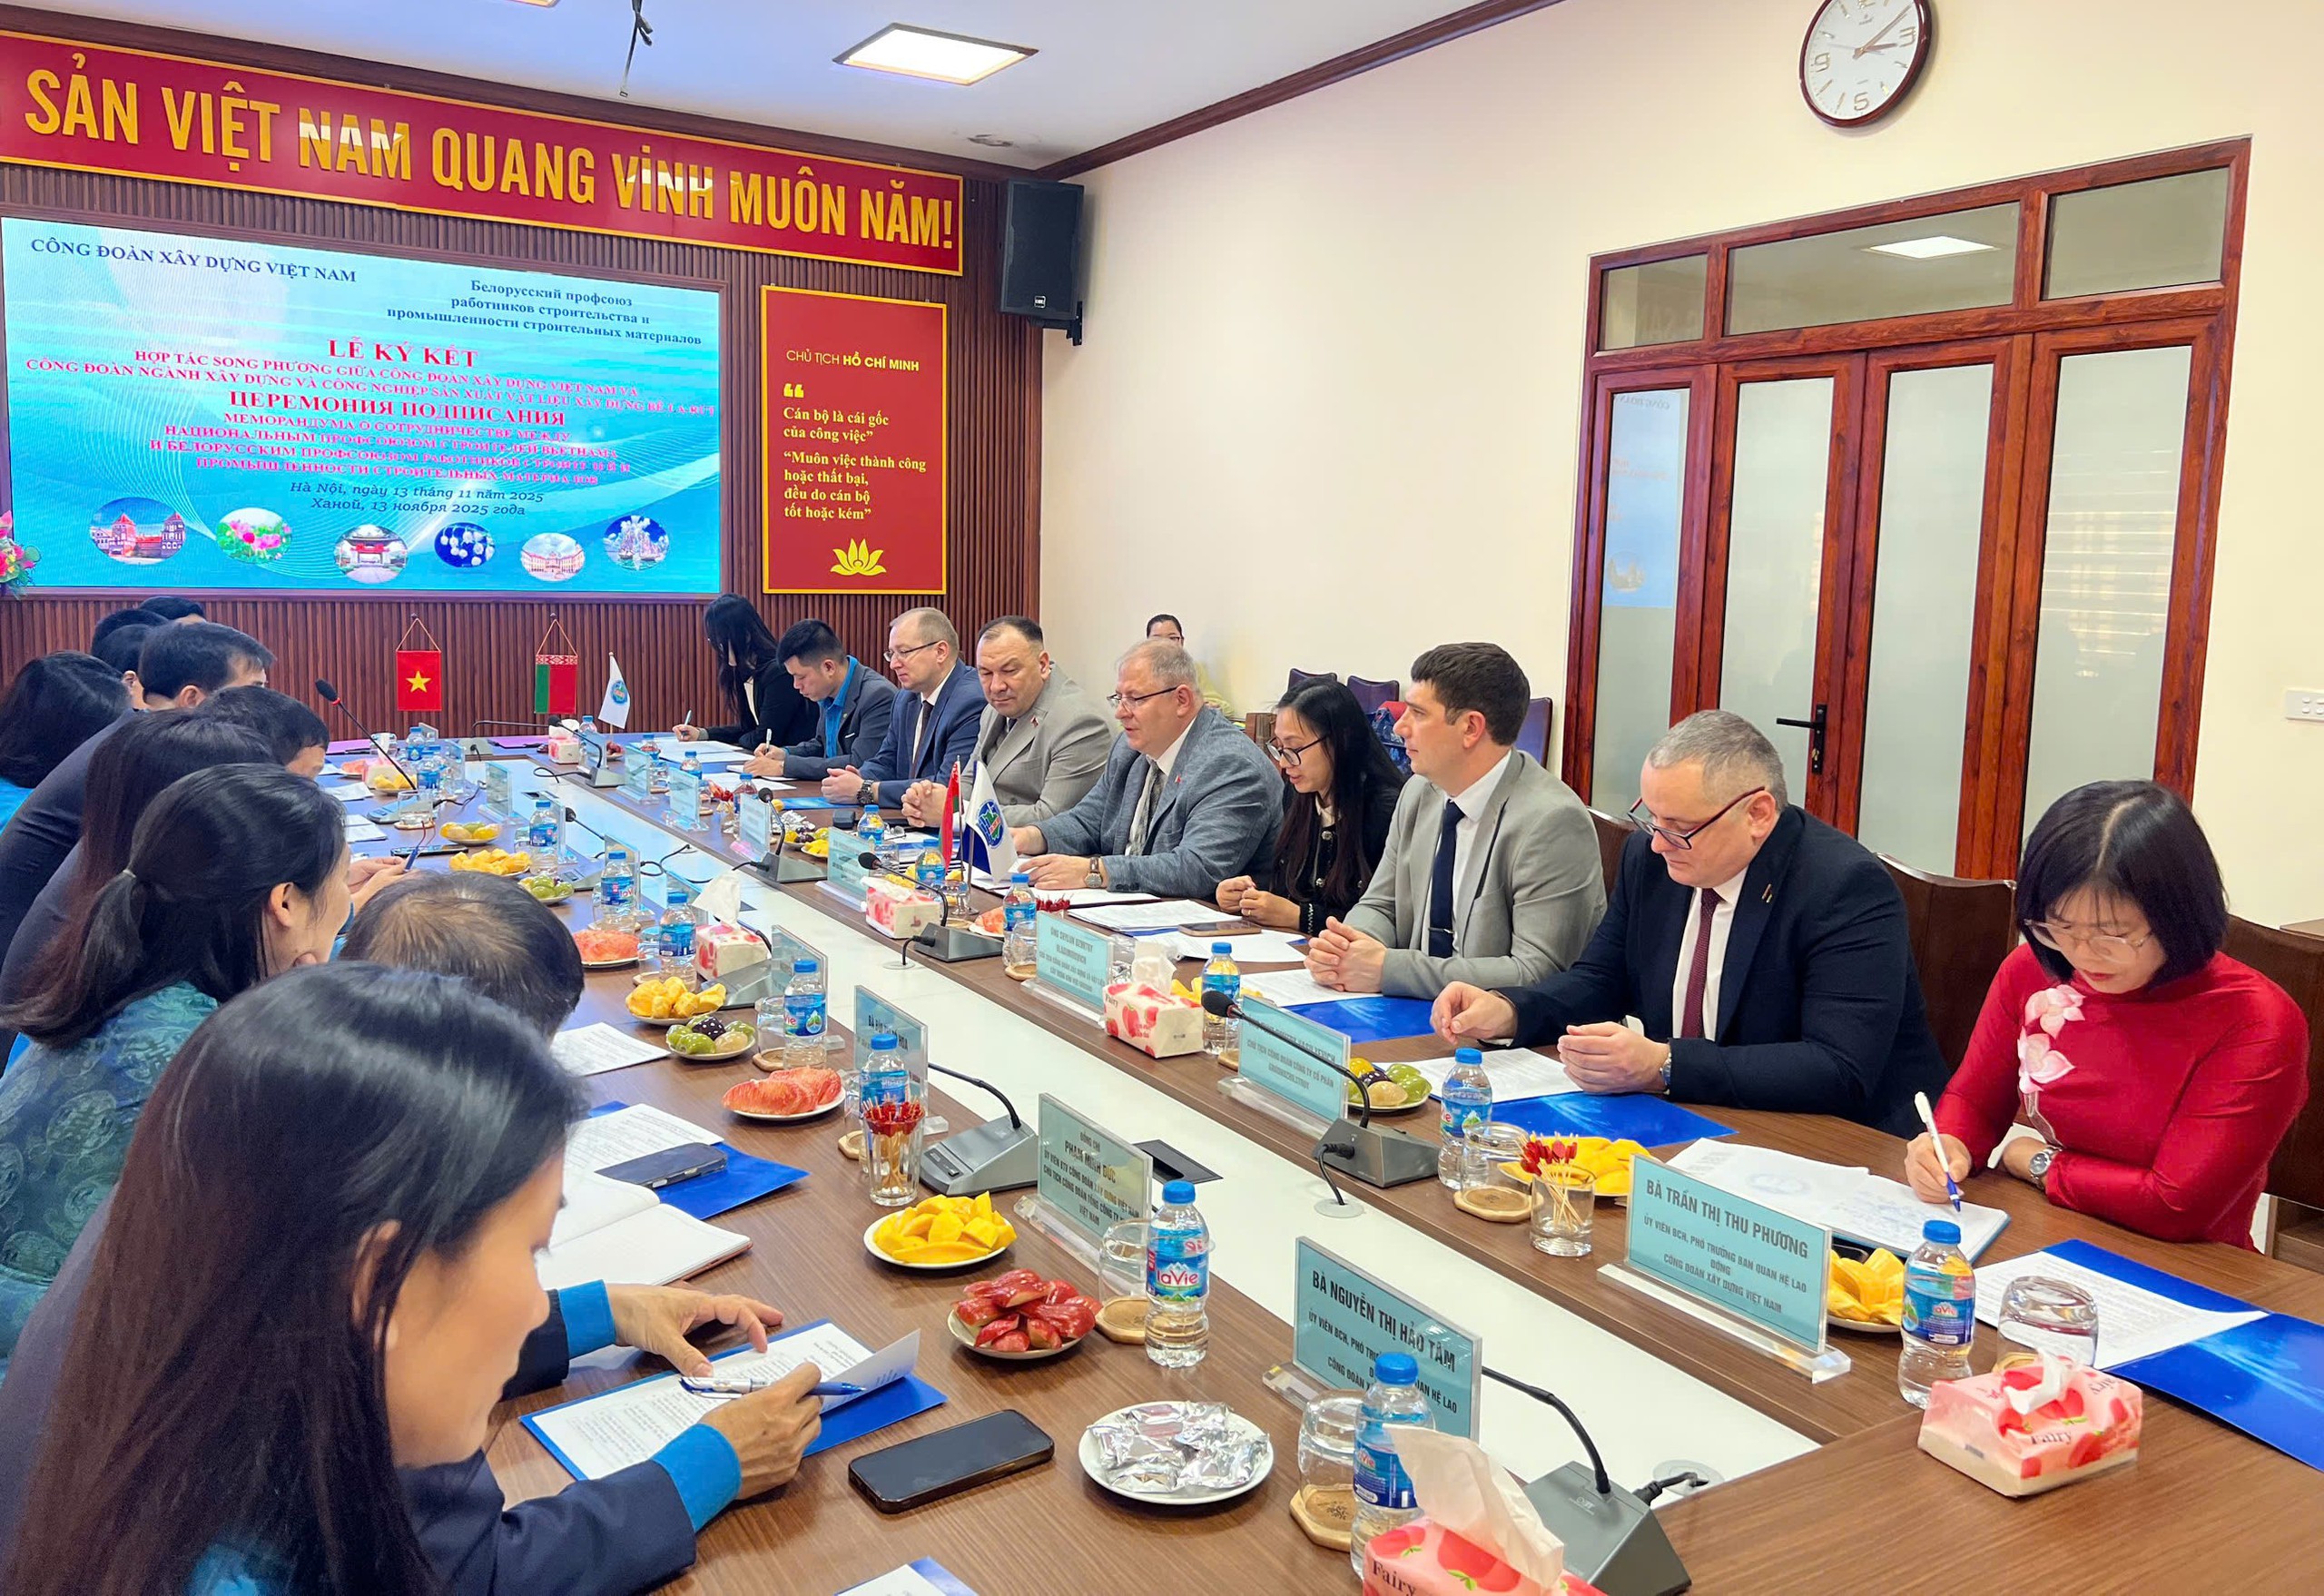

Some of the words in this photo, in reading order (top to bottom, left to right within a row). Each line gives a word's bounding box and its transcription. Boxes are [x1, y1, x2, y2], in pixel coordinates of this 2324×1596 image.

[25, 52, 140, 145] SẢN
[161, 81, 281, 172] VIỆT
[298, 107, 413, 182] NAM
[431, 127, 596, 205] QUANG
[730, 165, 847, 237] MUÔN
[861, 179, 954, 250] NĂM!
[31, 237, 91, 257] CÔNG
[97, 245, 154, 263] ĐOÀN
[160, 250, 201, 267] XÂY
[206, 255, 261, 274] DỰNG
[266, 260, 310, 280] VIỆT
[314, 268, 357, 282] NAM
[470, 280, 562, 300] Белорусский
[566, 292, 633, 308] профсоюз
[451, 297, 535, 314] работников
[538, 306, 637, 324] строительства
[641, 315, 651, 325] и
[387, 308, 519, 329] промышленности
[523, 320, 622, 339] строительных
[625, 330, 703, 346] материалов
[328, 337, 365, 360] LỄ
[375, 340, 411, 364] KÝ
[423, 344, 478, 368] KẾT
[786, 348, 812, 362] CHỦ
[815, 352, 840, 365] TỊCH
[843, 350, 862, 367] HỒ
[864, 355, 886, 369] CHÍ
[889, 359, 920, 371] MINH
[135, 350, 171, 365] HỢP
[174, 351, 209, 367] TÁC
[212, 355, 260, 369] SONG
[263, 358, 332, 375] PHƯƠNG
[337, 364, 376, 379] GIỮA
[379, 367, 423, 381] CÔNG
[428, 372, 469, 385] ĐOÀN
[473, 374, 502, 388] XÂY
[506, 379, 547, 391] DỰNG
[550, 381, 582, 394] VIỆT
[586, 384, 616, 395] NAM
[620, 386, 638, 397] VÀ
[230, 390, 394, 416] ЦЕРЕМОНИЯ
[401, 400, 566, 426] ПОДПИСАНИЯ
[783, 407, 810, 420] Cán
[813, 409, 830, 425] bộ
[832, 410, 844, 423] là
[847, 411, 865, 424] cái
[868, 410, 890, 428] gốc
[224, 412, 354, 430] МЕМОРАНДУМА
[359, 420, 371, 431] О
[374, 422, 513, 438] СОТРУДНИЧЕСТВЕ
[516, 430, 571, 442] МЕЖДУ
[783, 426, 806, 438] của
[810, 427, 840, 443] công
[783, 469, 814, 485] hoặc
[817, 468, 842, 483] thất
[846, 472, 869, 487] bại,
[832, 455, 856, 469] việc
[860, 456, 895, 468] thành
[898, 458, 927, 473] công
[290, 482, 311, 493] Hà
[316, 482, 347, 495] Nội,
[351, 486, 388, 497] ngày
[393, 488, 409, 498] 13
[413, 487, 453, 500] tháng
[458, 490, 471, 499] 11
[476, 489, 506, 500] năm
[509, 492, 544, 502] 2025
[783, 485, 807, 500] đều
[811, 488, 827, 501] do
[830, 488, 852, 502] cán
[855, 490, 871, 505] bộ
[311, 498, 365, 511] Ханой,
[371, 502, 387, 513] 13
[392, 502, 448, 515] ноября
[451, 503, 488, 515] 2025
[492, 506, 526, 516] года
[784, 504, 802, 517] tốt
[805, 506, 834, 521] hoặc
[1646, 1178, 1662, 1201] BÀ
[1701, 1201, 1720, 1227] THỊ
[1725, 1209, 1748, 1234] THU
[1752, 1222, 1808, 1258] PHƯƠNG
[1655, 1220, 1670, 1234] VIÊN
[1672, 1227, 1689, 1244] BCH,
[1707, 1241, 1736, 1263] TRƯỞNG
[1738, 1256, 1754, 1270] BAN
[1756, 1263, 1777, 1281] QUAN
[1778, 1272, 1790, 1286] HỆ
[1791, 1278, 1807, 1293] LAO
[1157, 1269, 1198, 1286] laVie
[1313, 1270, 1327, 1295] BÀ
[1330, 1280, 1374, 1324] NGUYỄN
[1378, 1309, 1397, 1341] THỊ
[1400, 1321, 1424, 1353] HẢO
[1428, 1339, 1455, 1373] TÂM
[1318, 1315, 1334, 1335] VIÊN
[1334, 1325, 1350, 1346] BCH,
[1432, 1387, 1442, 1405] HỆ
[1443, 1396, 1457, 1414] LAO
[1327, 1355, 1346, 1377] CÔNG
[1347, 1367, 1364, 1391] ĐOÀN
[2030, 1431, 2073, 1444] Fairy
[1372, 1559, 1417, 1596] Fairy
